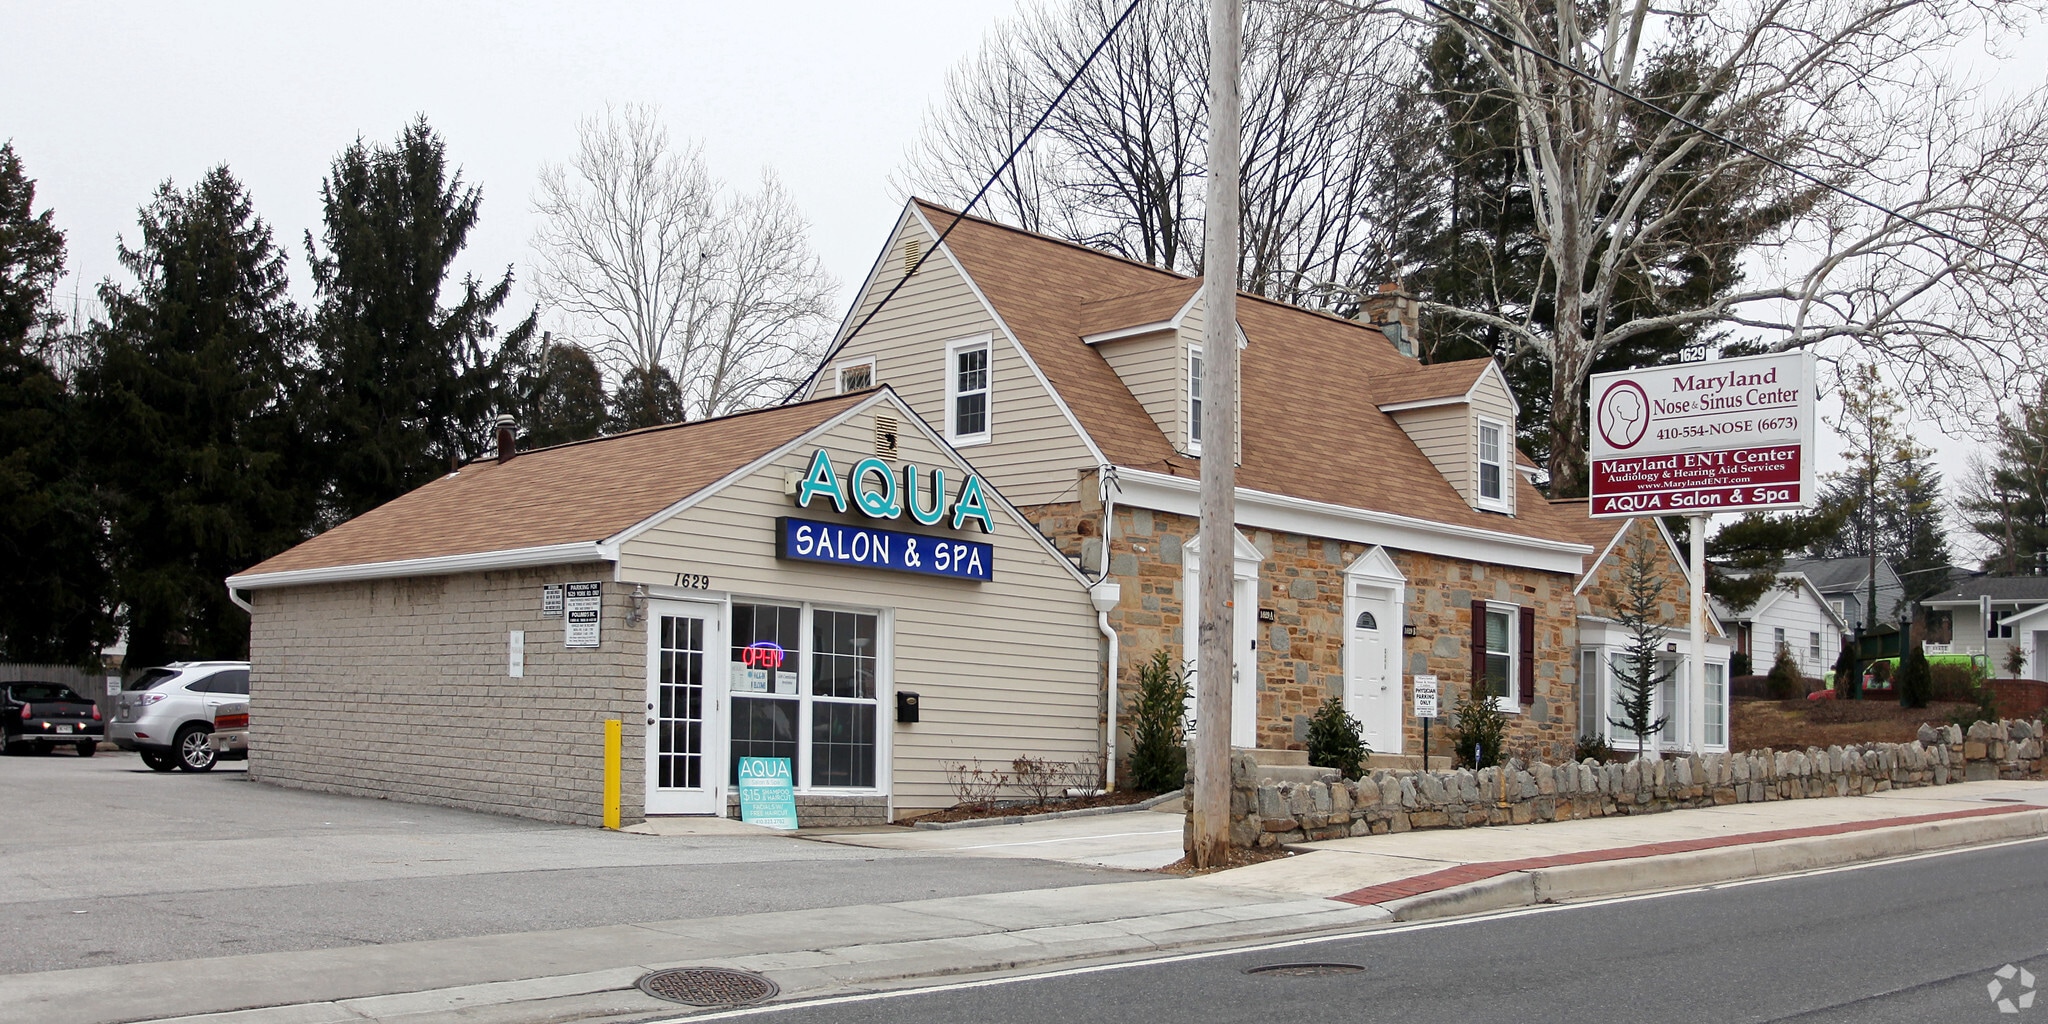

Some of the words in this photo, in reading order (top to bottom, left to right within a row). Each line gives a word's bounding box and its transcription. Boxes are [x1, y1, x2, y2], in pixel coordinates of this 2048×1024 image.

[1678, 346, 1706, 362] 1629
[1672, 367, 1777, 394] Maryland
[1653, 398, 1690, 416] Nose
[1691, 401, 1699, 410] &
[1700, 393, 1743, 411] Sinus
[1746, 387, 1799, 406] Center
[1656, 420, 1753, 441] 410-554-NOSE
[1757, 416, 1798, 433] (6673)
[1601, 456, 1677, 476] Maryland
[1683, 452, 1727, 468] ENT
[1733, 450, 1795, 464] Center
[1607, 471, 1659, 483] Audiology
[1662, 470, 1671, 479] &
[1674, 467, 1715, 479] Hearing
[1718, 464, 1738, 475] Aid
[1740, 462, 1785, 474] Services
[795, 448, 995, 534] AQUA
[1637, 475, 1751, 490] www.MarylandENT.com
[1604, 495, 1661, 511] AQUA
[1669, 490, 1720, 507] Salon
[1729, 488, 1743, 503] &
[1752, 487, 1789, 504] Spa
[796, 525, 889, 564] SALON
[904, 538, 921, 568] &
[934, 542, 983, 576] SPA
[674, 572, 709, 590] 1629
[742, 646, 783, 668] OPEN
[741, 760, 789, 777] AQUA
[743, 788, 761, 801] $15
